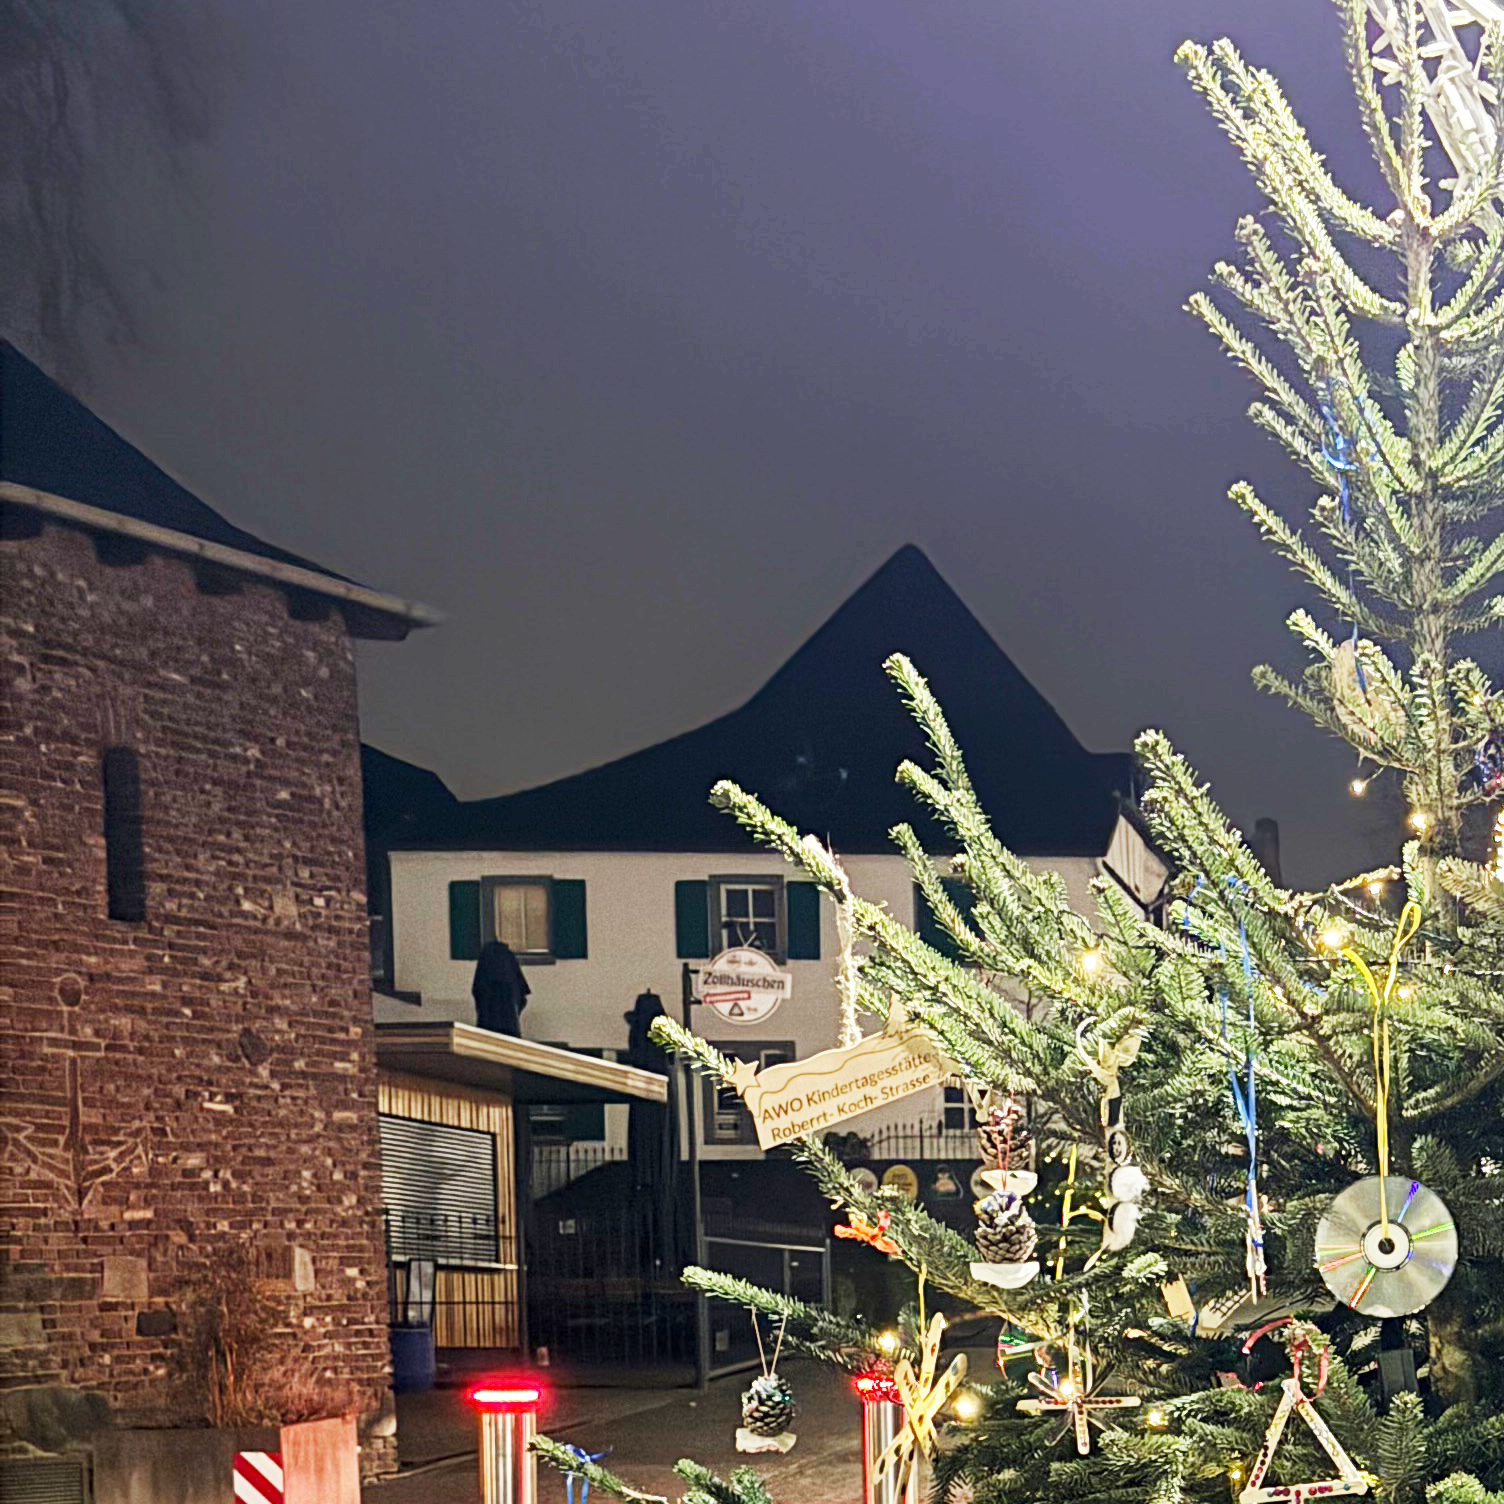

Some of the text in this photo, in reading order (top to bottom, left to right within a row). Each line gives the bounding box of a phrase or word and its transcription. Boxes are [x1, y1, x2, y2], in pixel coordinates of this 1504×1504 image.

[703, 972, 785, 990] Zollhäuschen
[762, 1051, 932, 1125] AWO Kindertagesstätte
[836, 1092, 879, 1118] Koch-
[881, 1072, 931, 1101] Strasse
